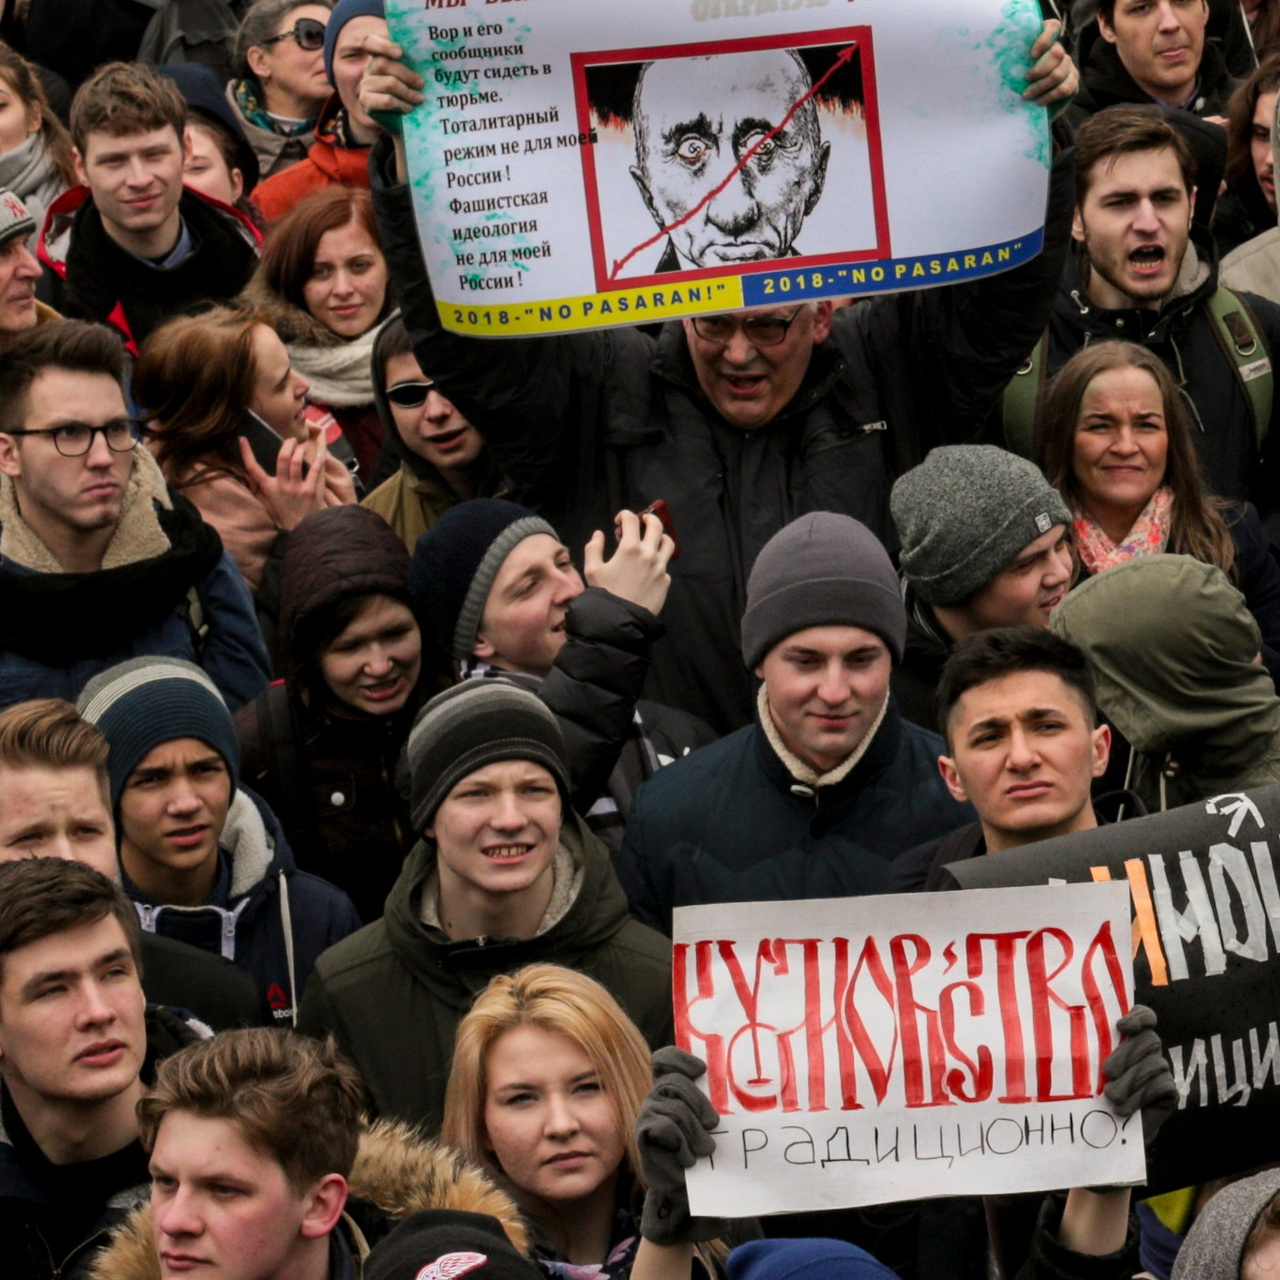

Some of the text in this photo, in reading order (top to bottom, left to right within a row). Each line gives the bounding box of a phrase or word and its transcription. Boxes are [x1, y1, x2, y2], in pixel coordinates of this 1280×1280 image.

[428, 23, 503, 42] Вор и его
[431, 44, 524, 62] сообщники
[434, 63, 552, 86] будут сидеть в
[436, 89, 503, 110] тюрьме.
[439, 106, 560, 135] Тоталитарный
[443, 127, 598, 166] режим не для моей
[449, 190, 549, 214] Фашистская
[452, 219, 538, 242] идеология
[456, 241, 552, 267] не для моей
[1205, 793, 1265, 838] Я
